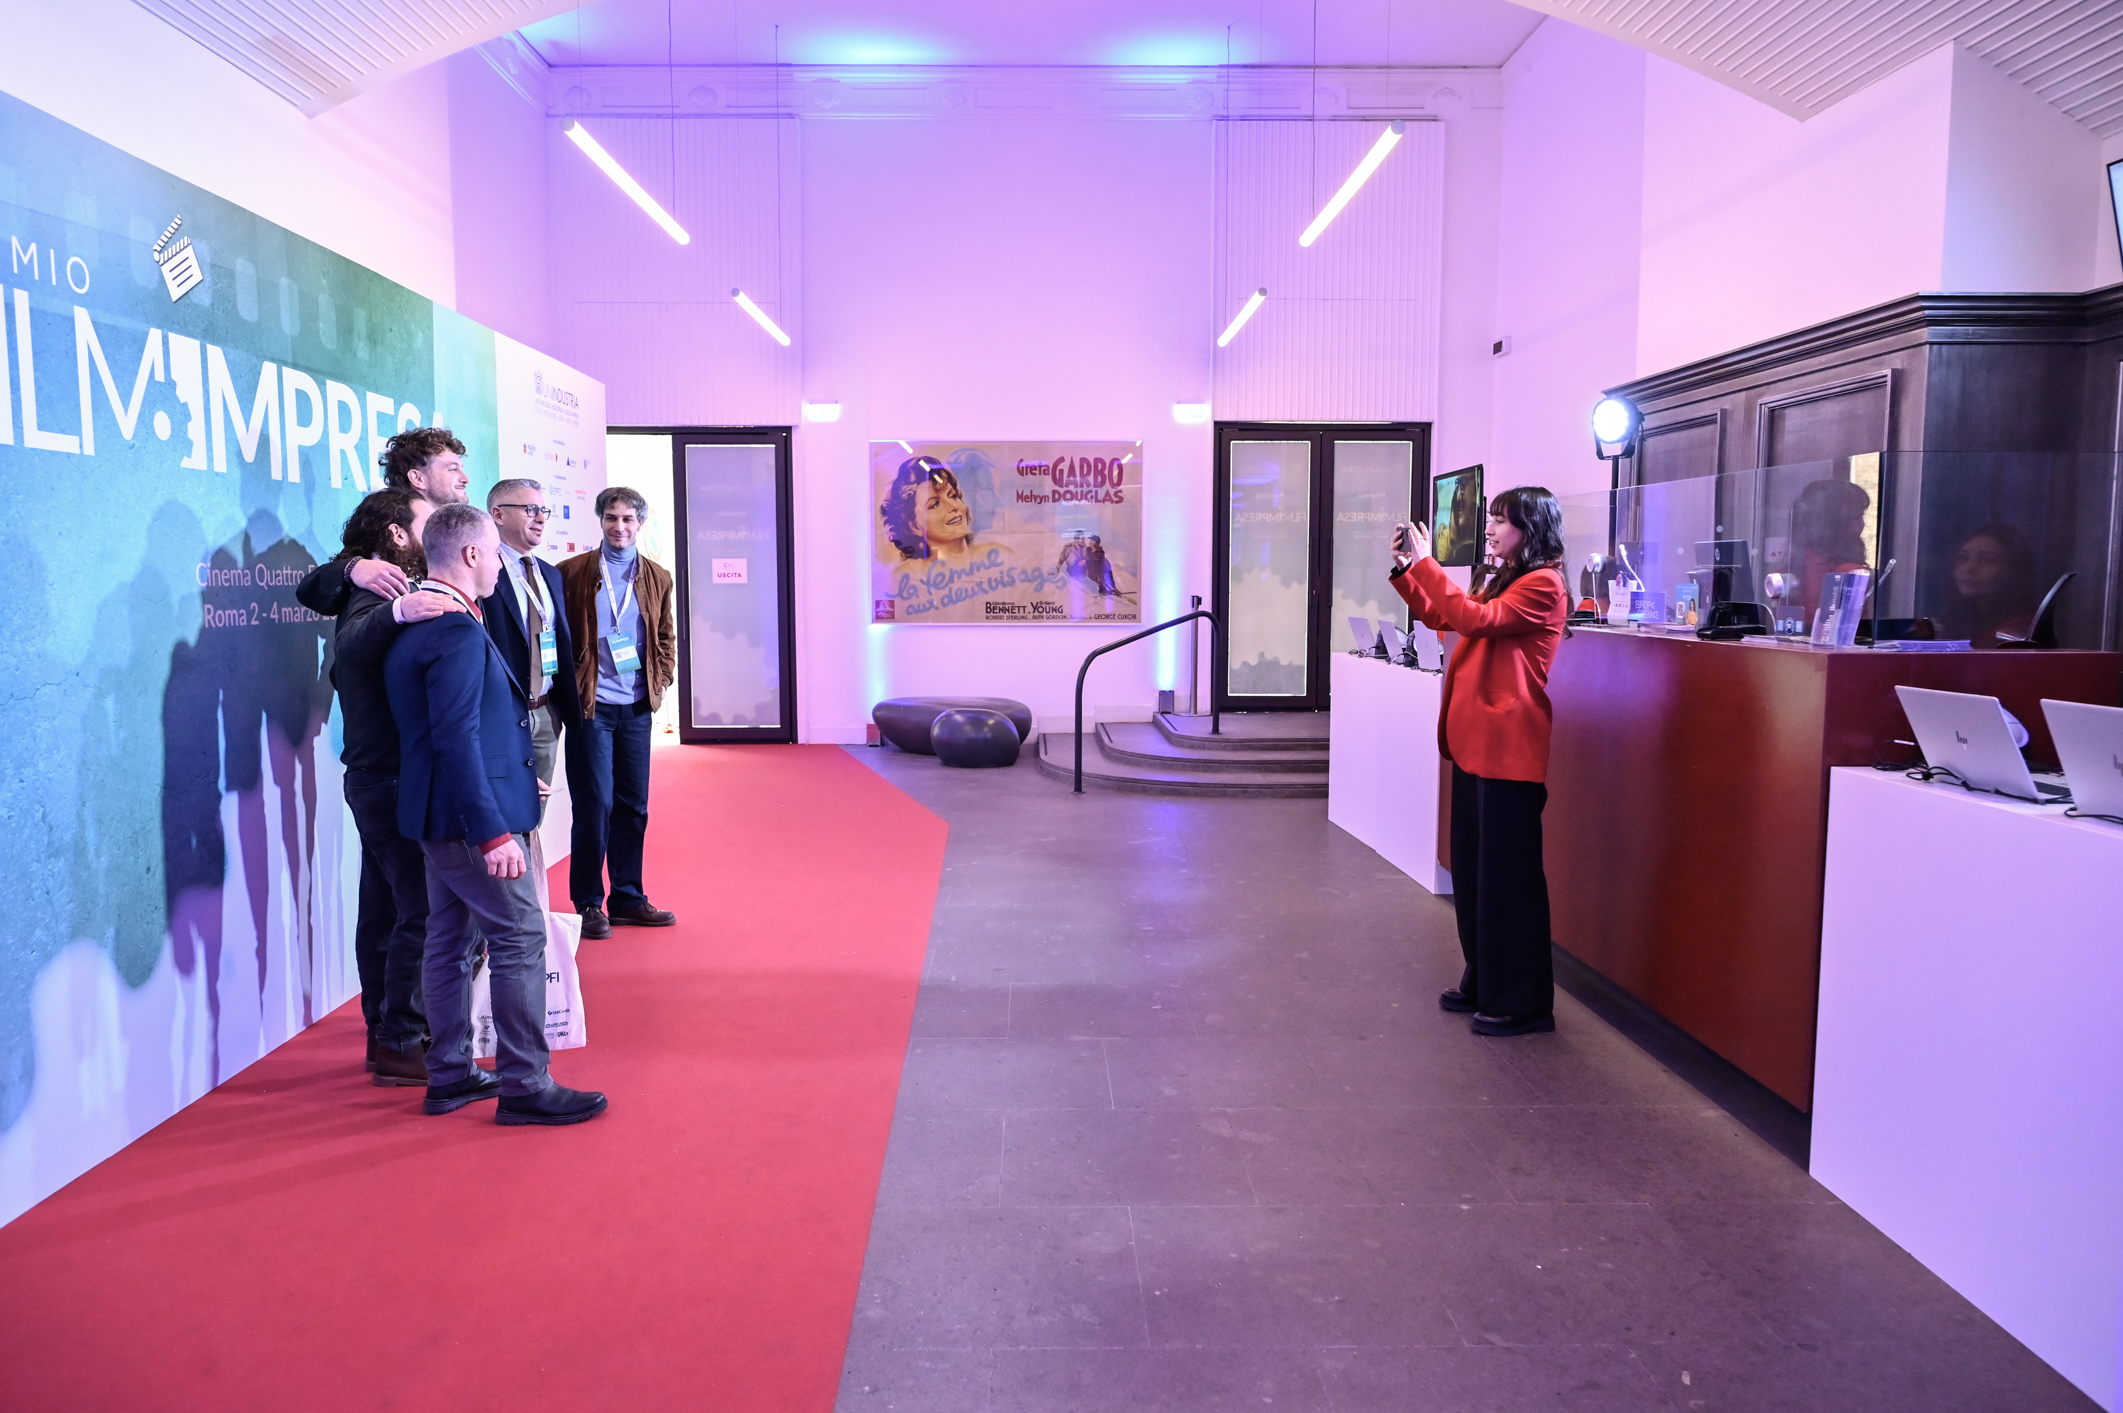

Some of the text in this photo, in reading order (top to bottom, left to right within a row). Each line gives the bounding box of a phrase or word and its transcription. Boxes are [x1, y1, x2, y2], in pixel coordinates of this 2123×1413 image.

[168, 331, 444, 493] IMPRE
[1016, 455, 1124, 489] Greta GARBO
[1016, 489, 1124, 505] Melvyn DOUGLAS
[195, 562, 251, 587] Cinema
[255, 563, 305, 591] Quattro
[204, 603, 247, 629] Roma
[250, 602, 260, 626] 2
[269, 601, 279, 623] 4
[1030, 601, 1064, 614] YOUNG
